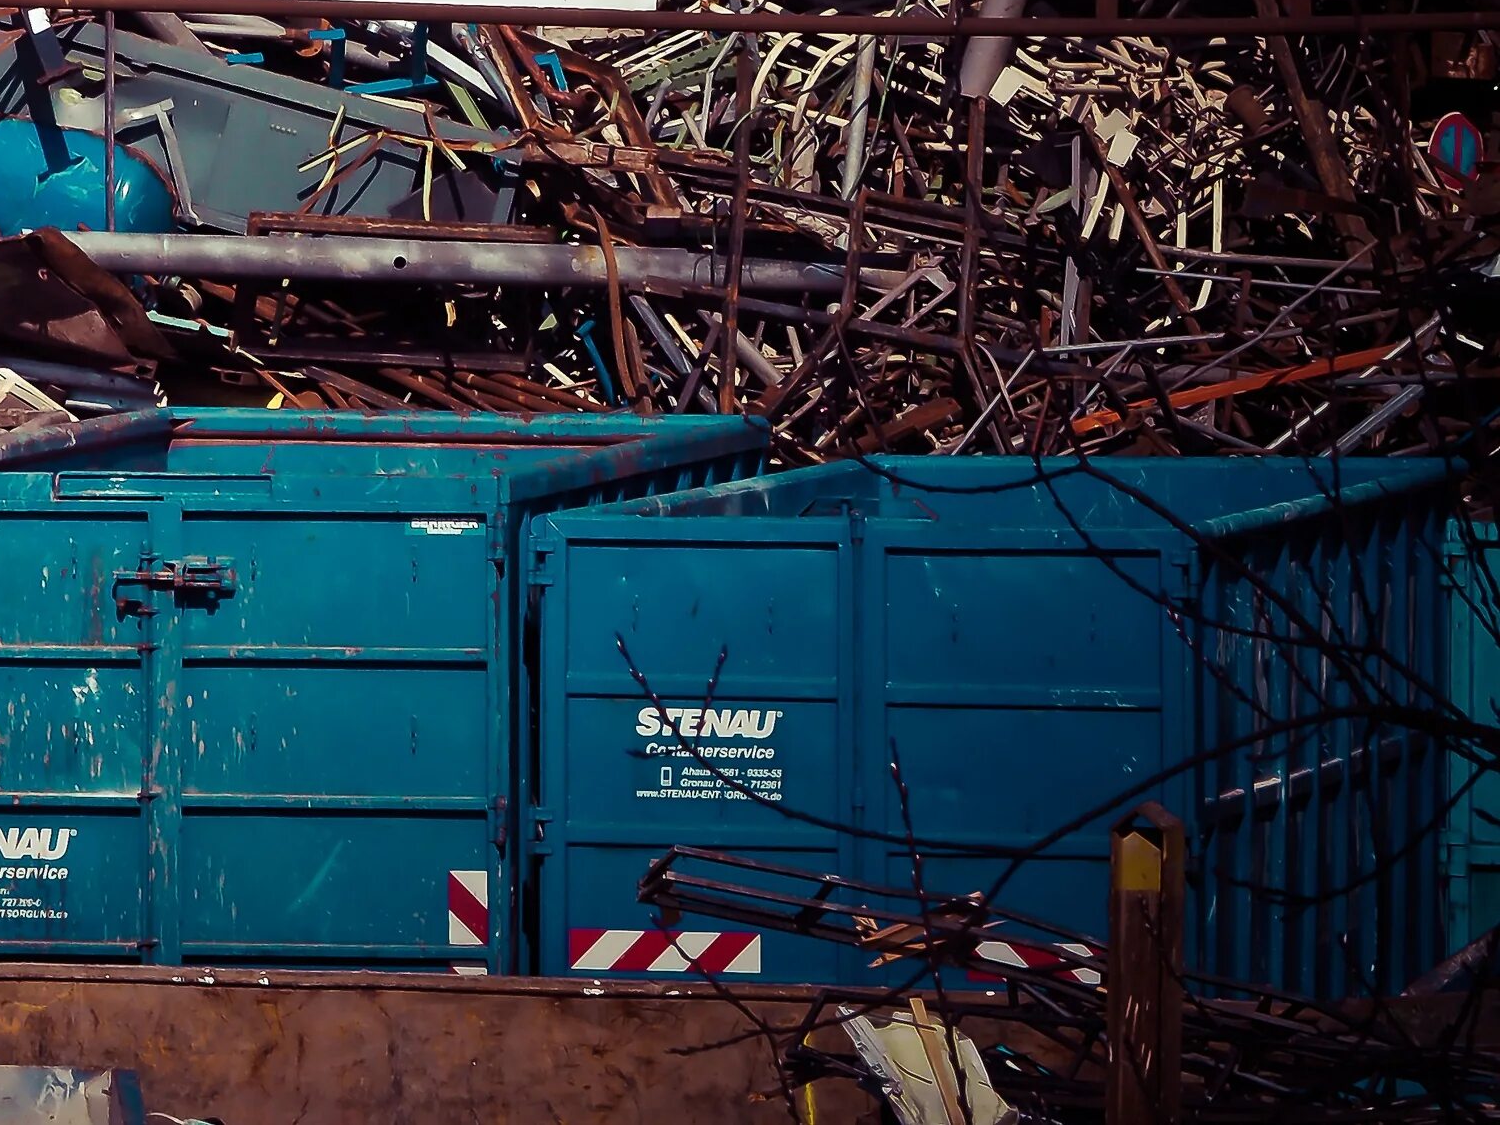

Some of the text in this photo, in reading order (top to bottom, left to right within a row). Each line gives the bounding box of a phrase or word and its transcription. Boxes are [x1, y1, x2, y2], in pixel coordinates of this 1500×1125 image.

[635, 707, 777, 739] STENAU
[681, 766, 711, 776] Ahaus
[680, 778, 714, 788] Gronau
[635, 788, 783, 801] www.STENAU-ENTORGNG.de
